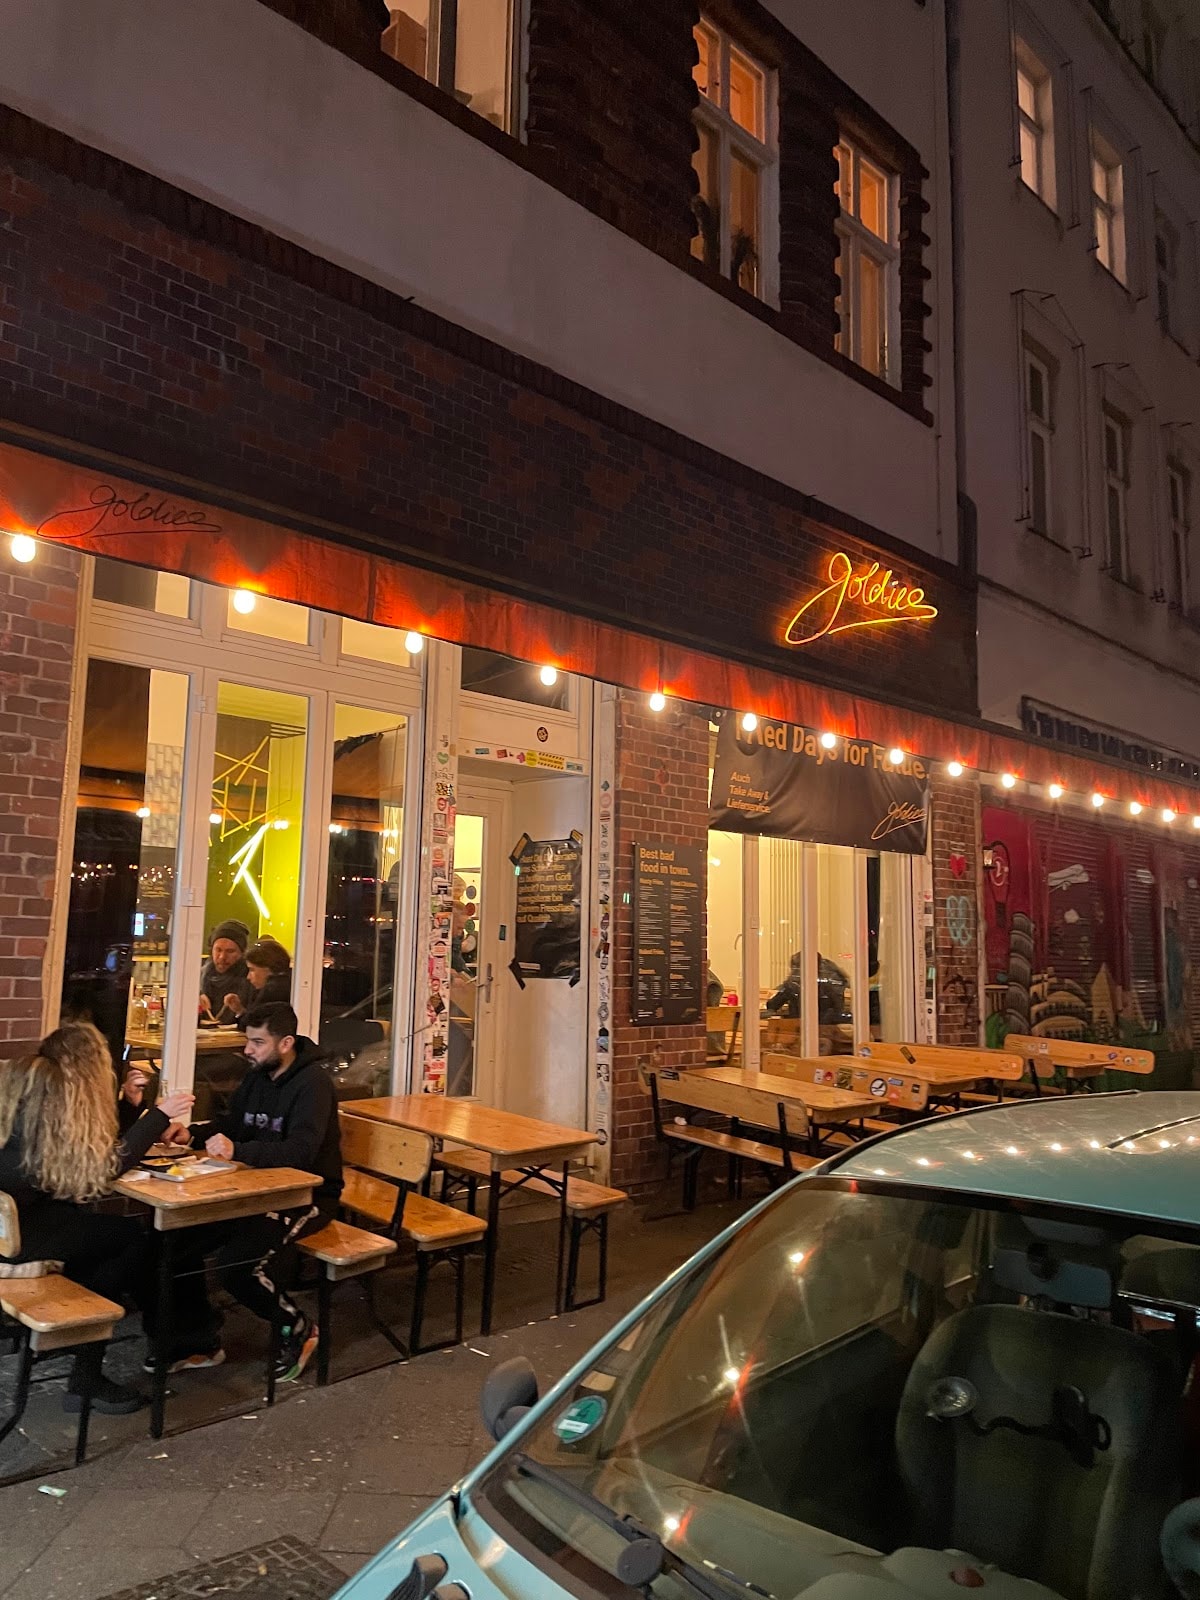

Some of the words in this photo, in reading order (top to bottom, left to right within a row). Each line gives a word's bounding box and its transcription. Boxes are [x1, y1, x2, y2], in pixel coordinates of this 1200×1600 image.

[843, 738, 869, 767] for
[872, 743, 930, 780] Fuue.
[730, 771, 752, 783] Auch
[639, 847, 659, 860] Best
[660, 849, 675, 861] bad
[640, 861, 659, 873] food
[660, 863, 668, 874] in
